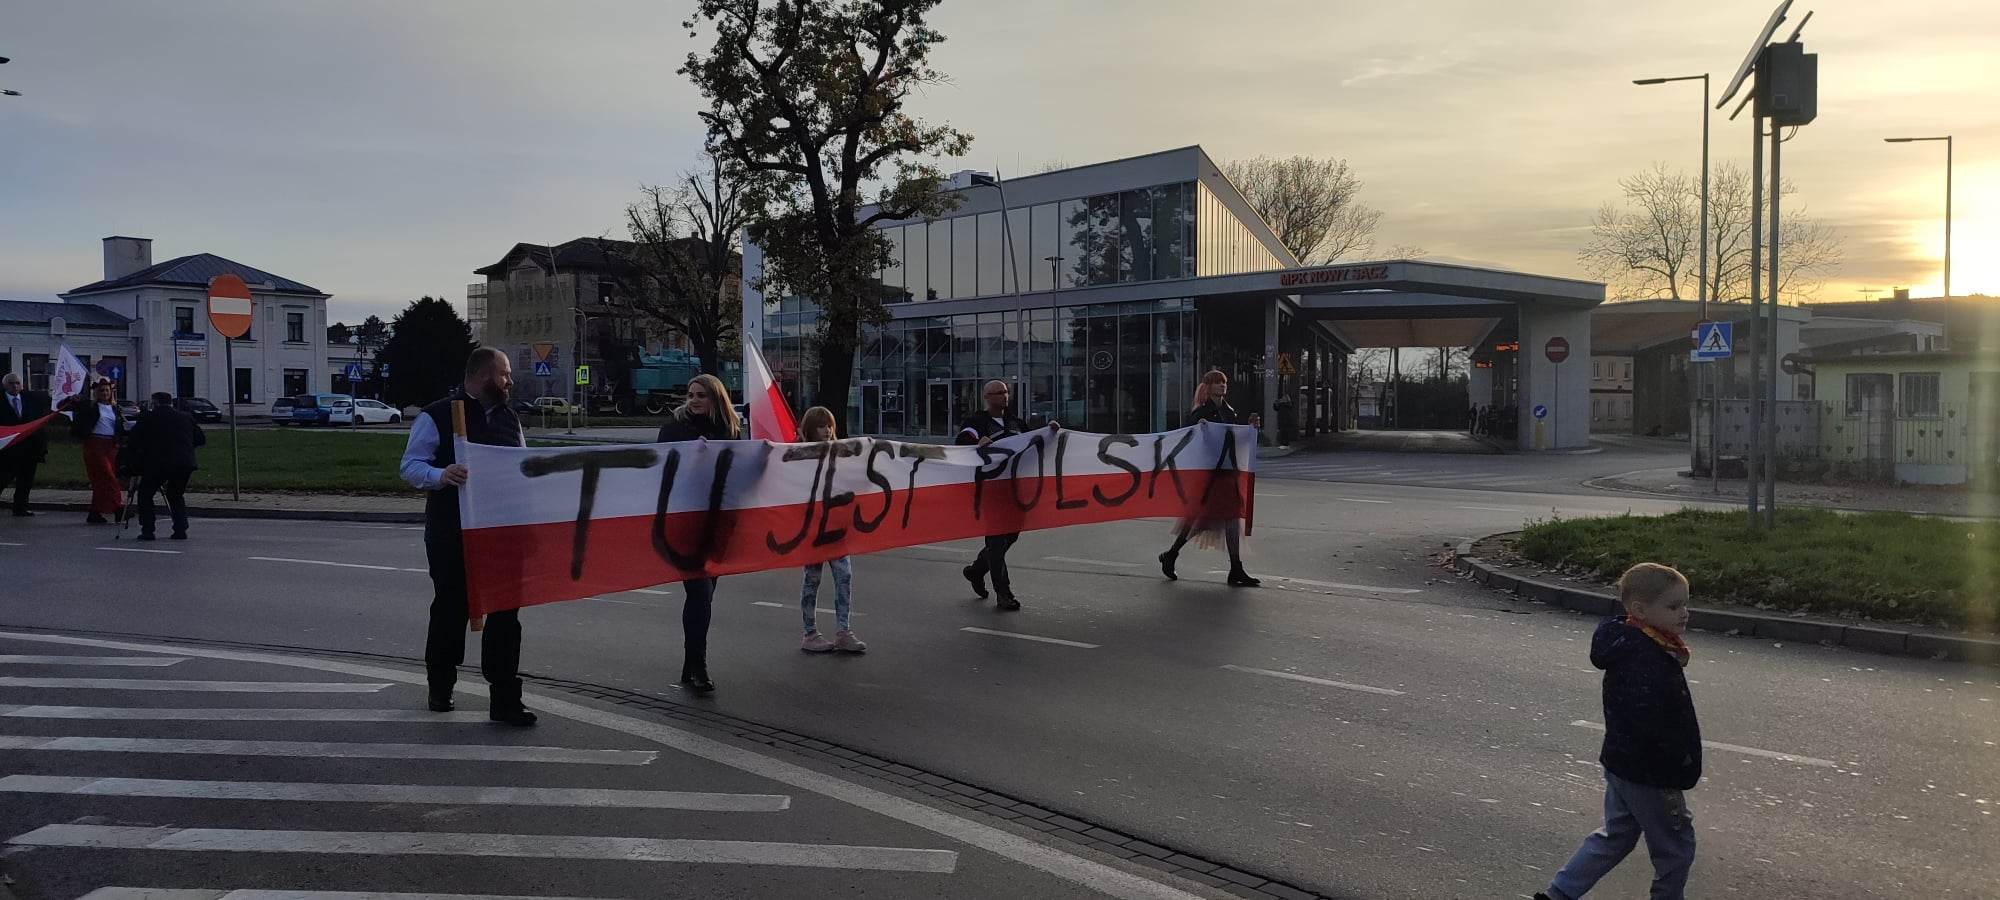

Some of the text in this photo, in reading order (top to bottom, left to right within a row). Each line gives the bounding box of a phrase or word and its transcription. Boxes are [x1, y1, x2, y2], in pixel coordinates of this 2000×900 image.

[1281, 272, 1309, 286] MPK
[1310, 269, 1349, 283] NOWY
[520, 427, 1244, 580] TU JEST POLSKA
